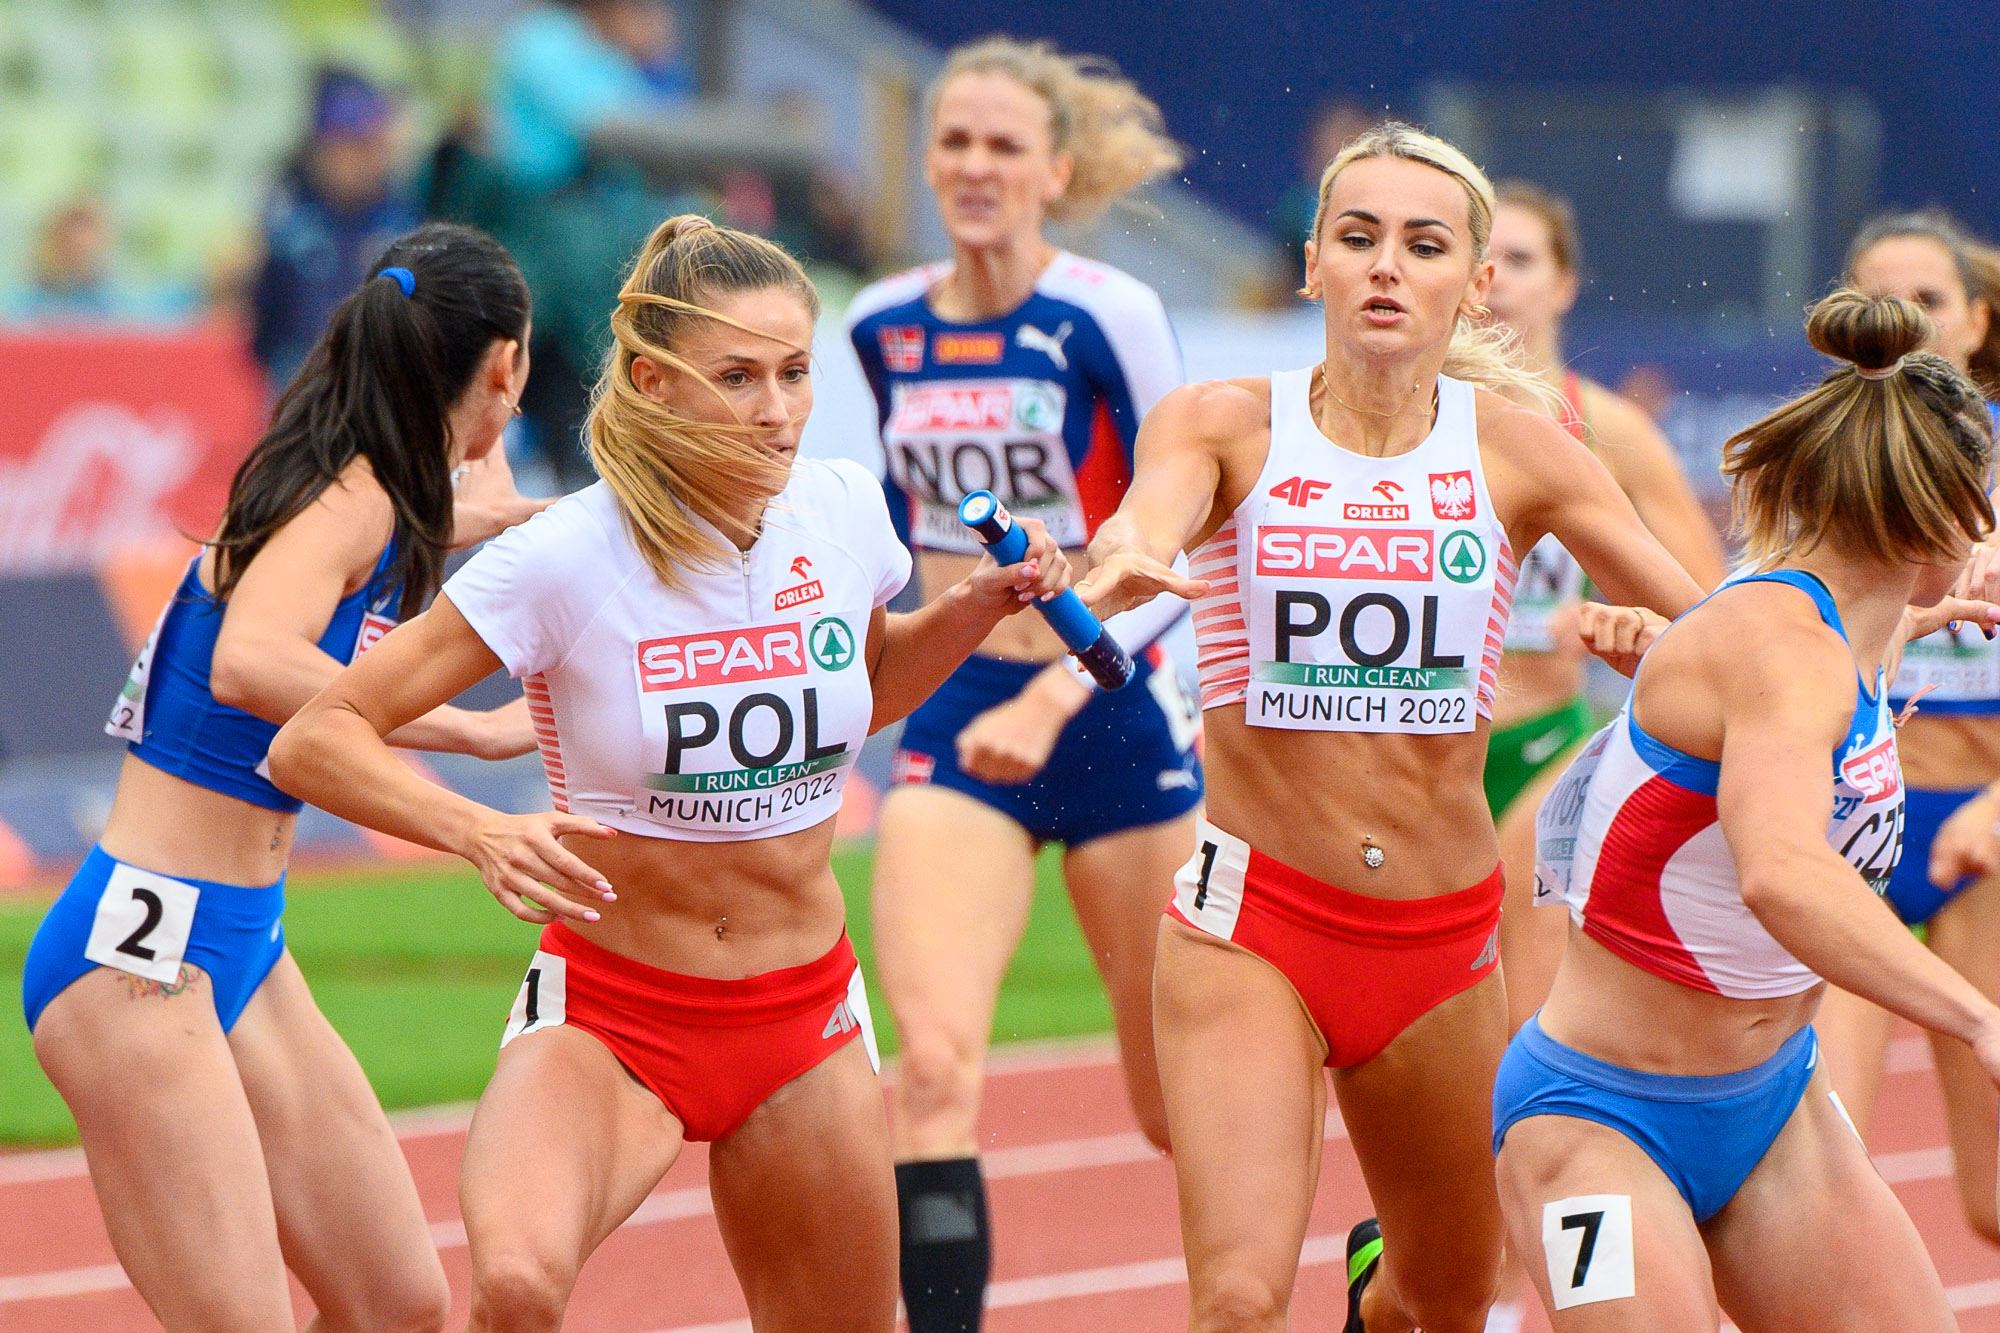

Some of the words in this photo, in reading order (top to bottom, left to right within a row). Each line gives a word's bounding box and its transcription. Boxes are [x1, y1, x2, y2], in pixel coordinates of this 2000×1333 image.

[900, 440, 1060, 504] NOR
[1269, 476, 1332, 508] 4F
[1346, 506, 1406, 519] ORLEN
[1261, 533, 1428, 574] SPAR
[776, 580, 820, 606] ORLEN
[1275, 590, 1465, 669] POL
[643, 632, 801, 684] SPAR
[1304, 668, 1311, 684] I
[1315, 669, 1358, 686] RUN
[664, 687, 848, 775] POL
[1261, 691, 1385, 722] MUNICH
[1399, 697, 1466, 725] 2022
[648, 795, 773, 823] MUNICH
[780, 773, 837, 814] 2022
[694, 777, 700, 791] I
[706, 770, 749, 790] RUN
[1194, 840, 1218, 911] 1
[115, 888, 163, 961] 2
[519, 968, 541, 1034] 1
[1562, 1211, 1605, 1288] 7
